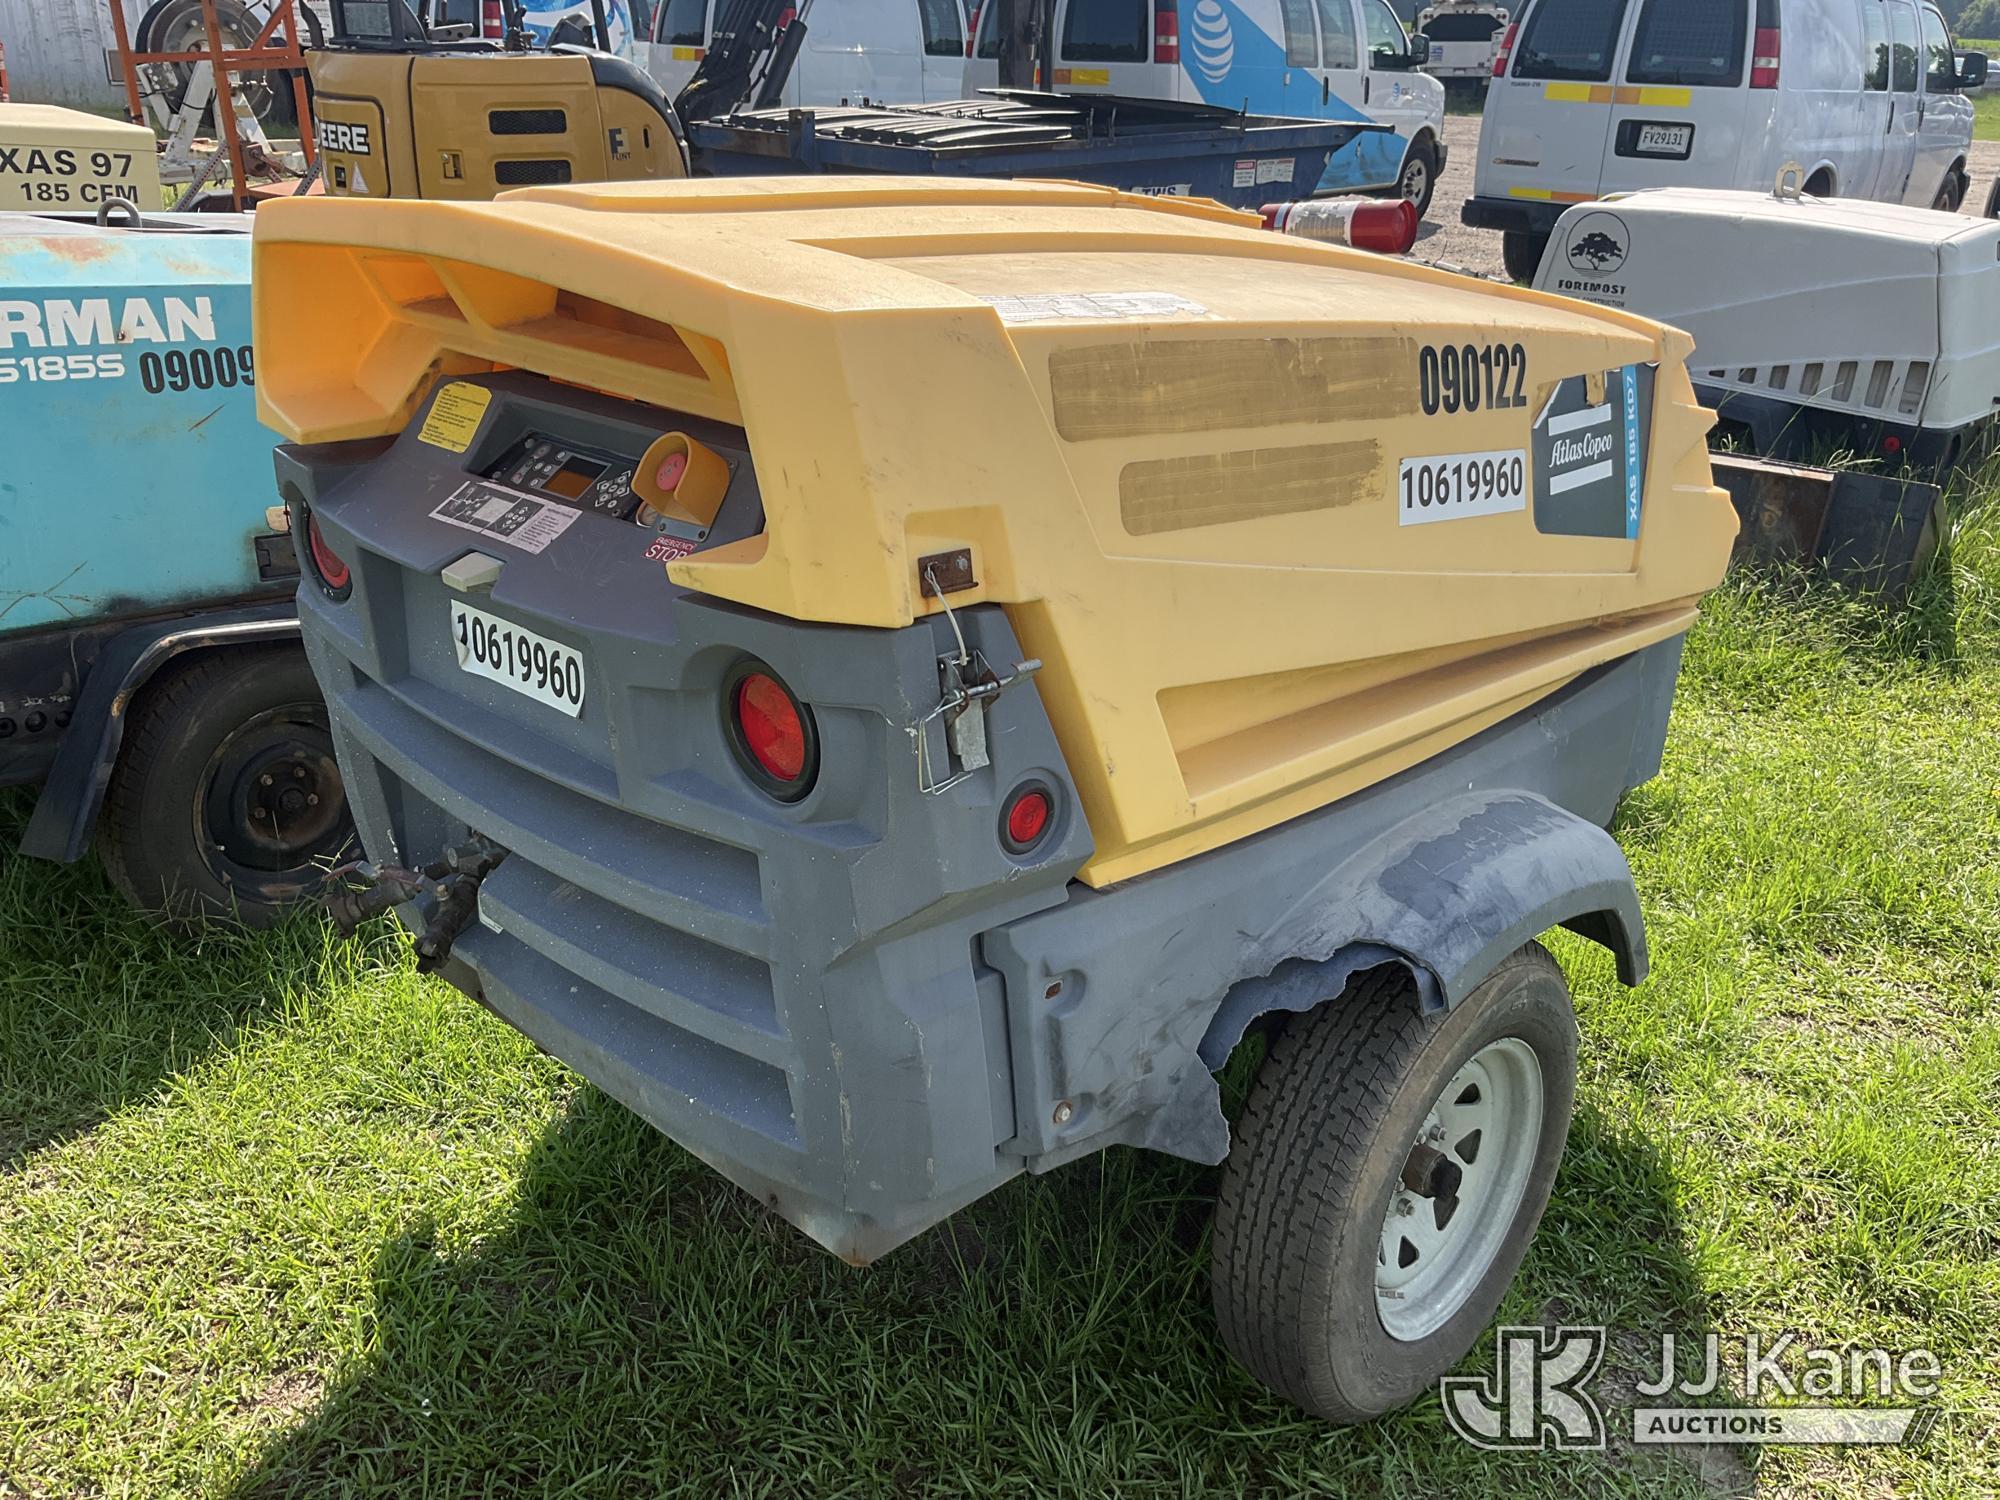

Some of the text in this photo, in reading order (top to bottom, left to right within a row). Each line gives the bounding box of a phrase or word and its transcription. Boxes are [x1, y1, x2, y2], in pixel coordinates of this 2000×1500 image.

[1642, 131, 1683, 146] FV29131
[0, 147, 132, 177] XAS 97
[20, 182, 139, 204] 185 CFM
[1558, 279, 1626, 295] FOREMOST
[0, 297, 216, 348] RMAN
[1419, 343, 1527, 416] 090122
[1626, 375, 1638, 522] XAS 185 KD7
[1401, 456, 1523, 509] 10619960
[645, 544, 688, 562] STOP
[457, 612, 581, 705] 10619960
